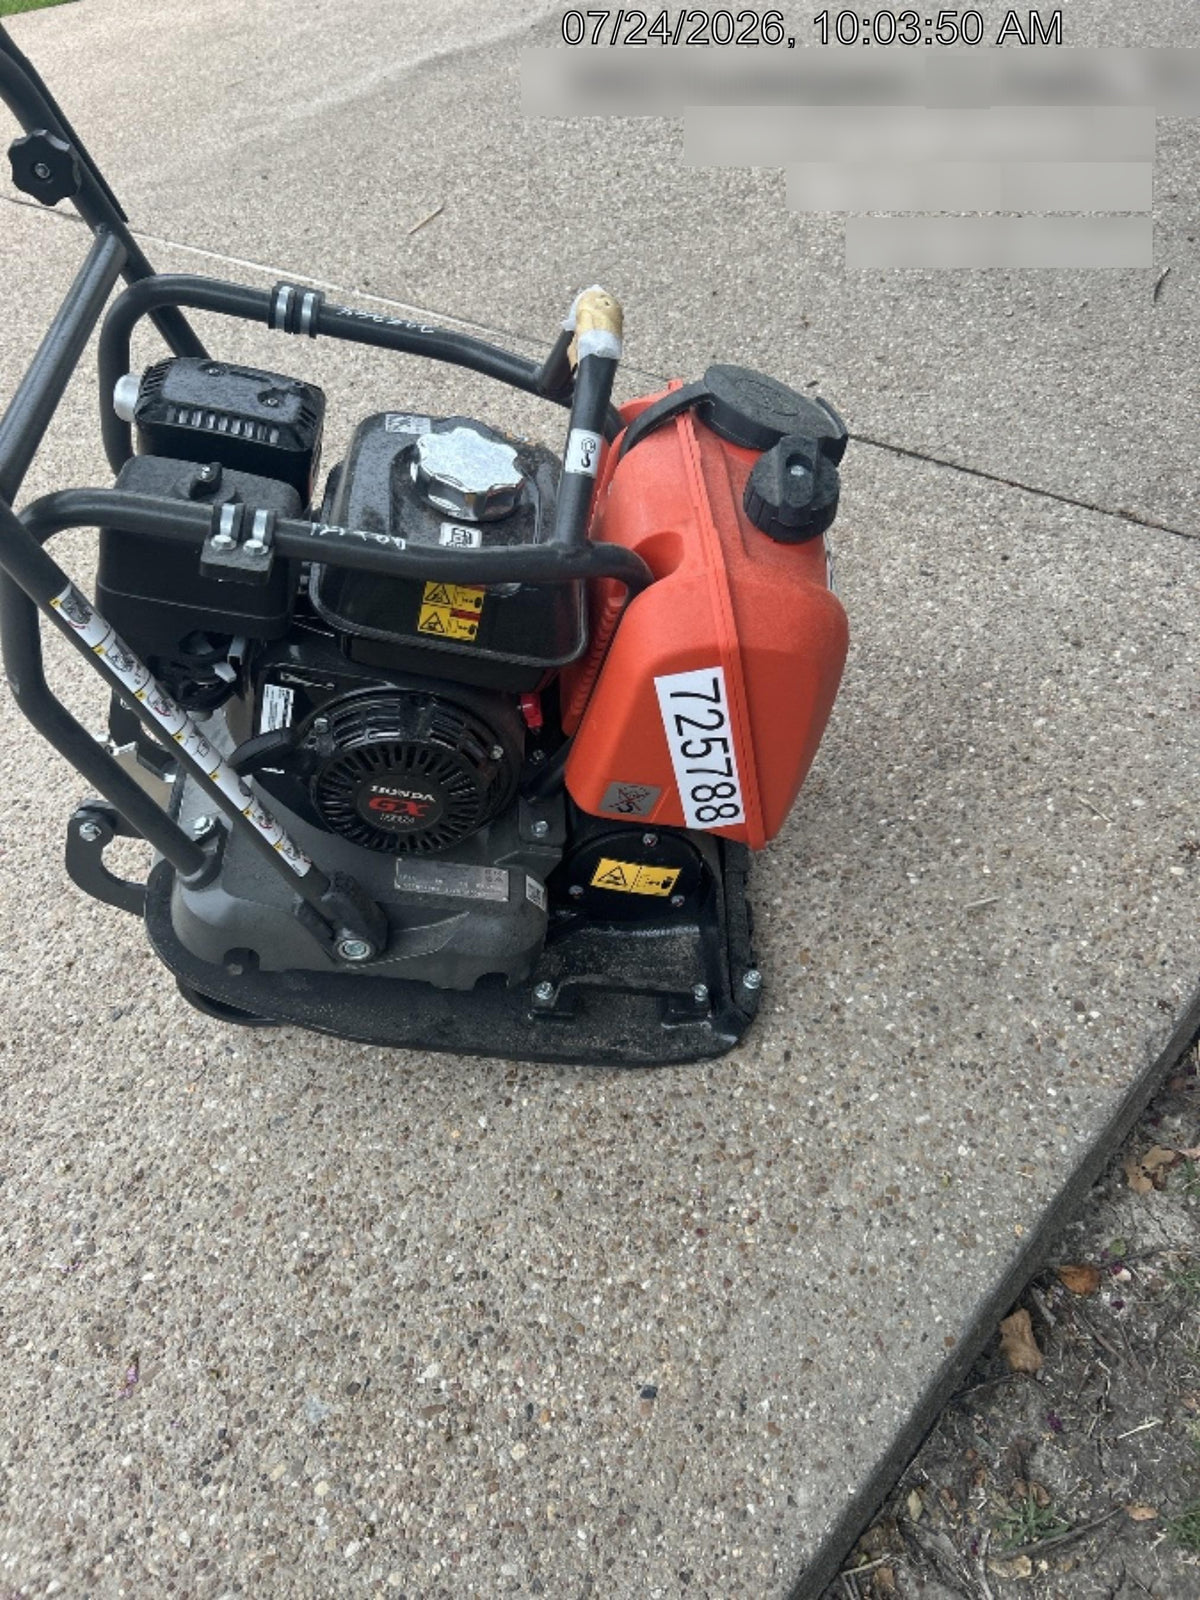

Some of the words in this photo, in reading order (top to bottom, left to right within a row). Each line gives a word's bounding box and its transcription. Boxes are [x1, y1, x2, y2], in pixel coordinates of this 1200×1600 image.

[670, 677, 740, 822] 725788
[370, 785, 436, 802] HONDA
[369, 797, 430, 817] GX
